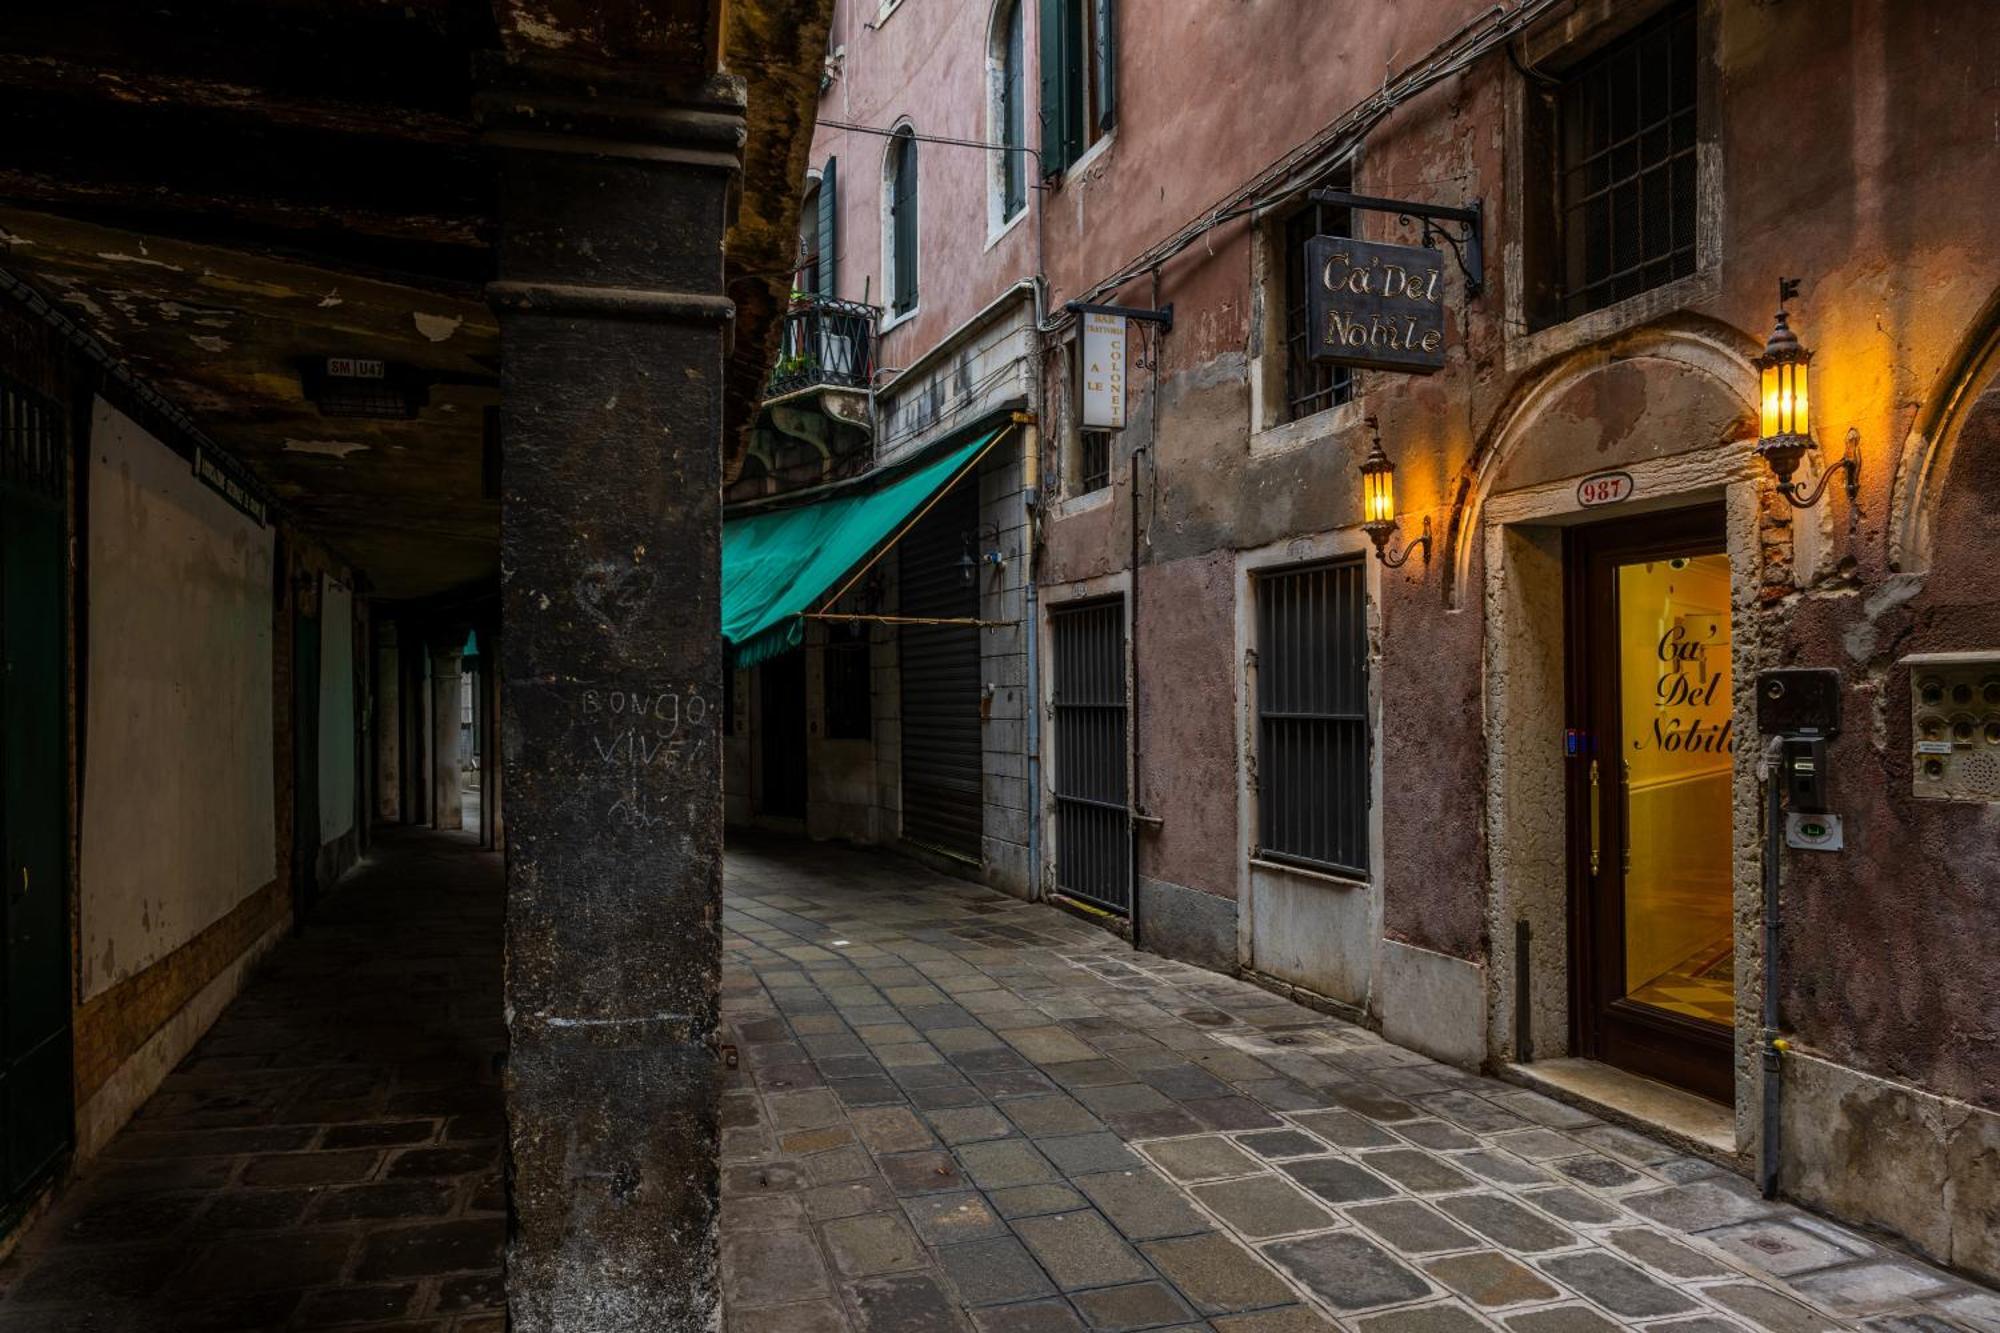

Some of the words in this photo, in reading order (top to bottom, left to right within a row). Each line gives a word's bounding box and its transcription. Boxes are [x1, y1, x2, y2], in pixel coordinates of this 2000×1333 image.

[1381, 264, 1441, 303] Del
[1323, 311, 1442, 353] Nobile
[1090, 362, 1099, 374] A
[1088, 382, 1103, 392] LE
[1584, 479, 1621, 503] 987
[1658, 624, 1717, 662] Ca'
[1655, 672, 1722, 707] Del
